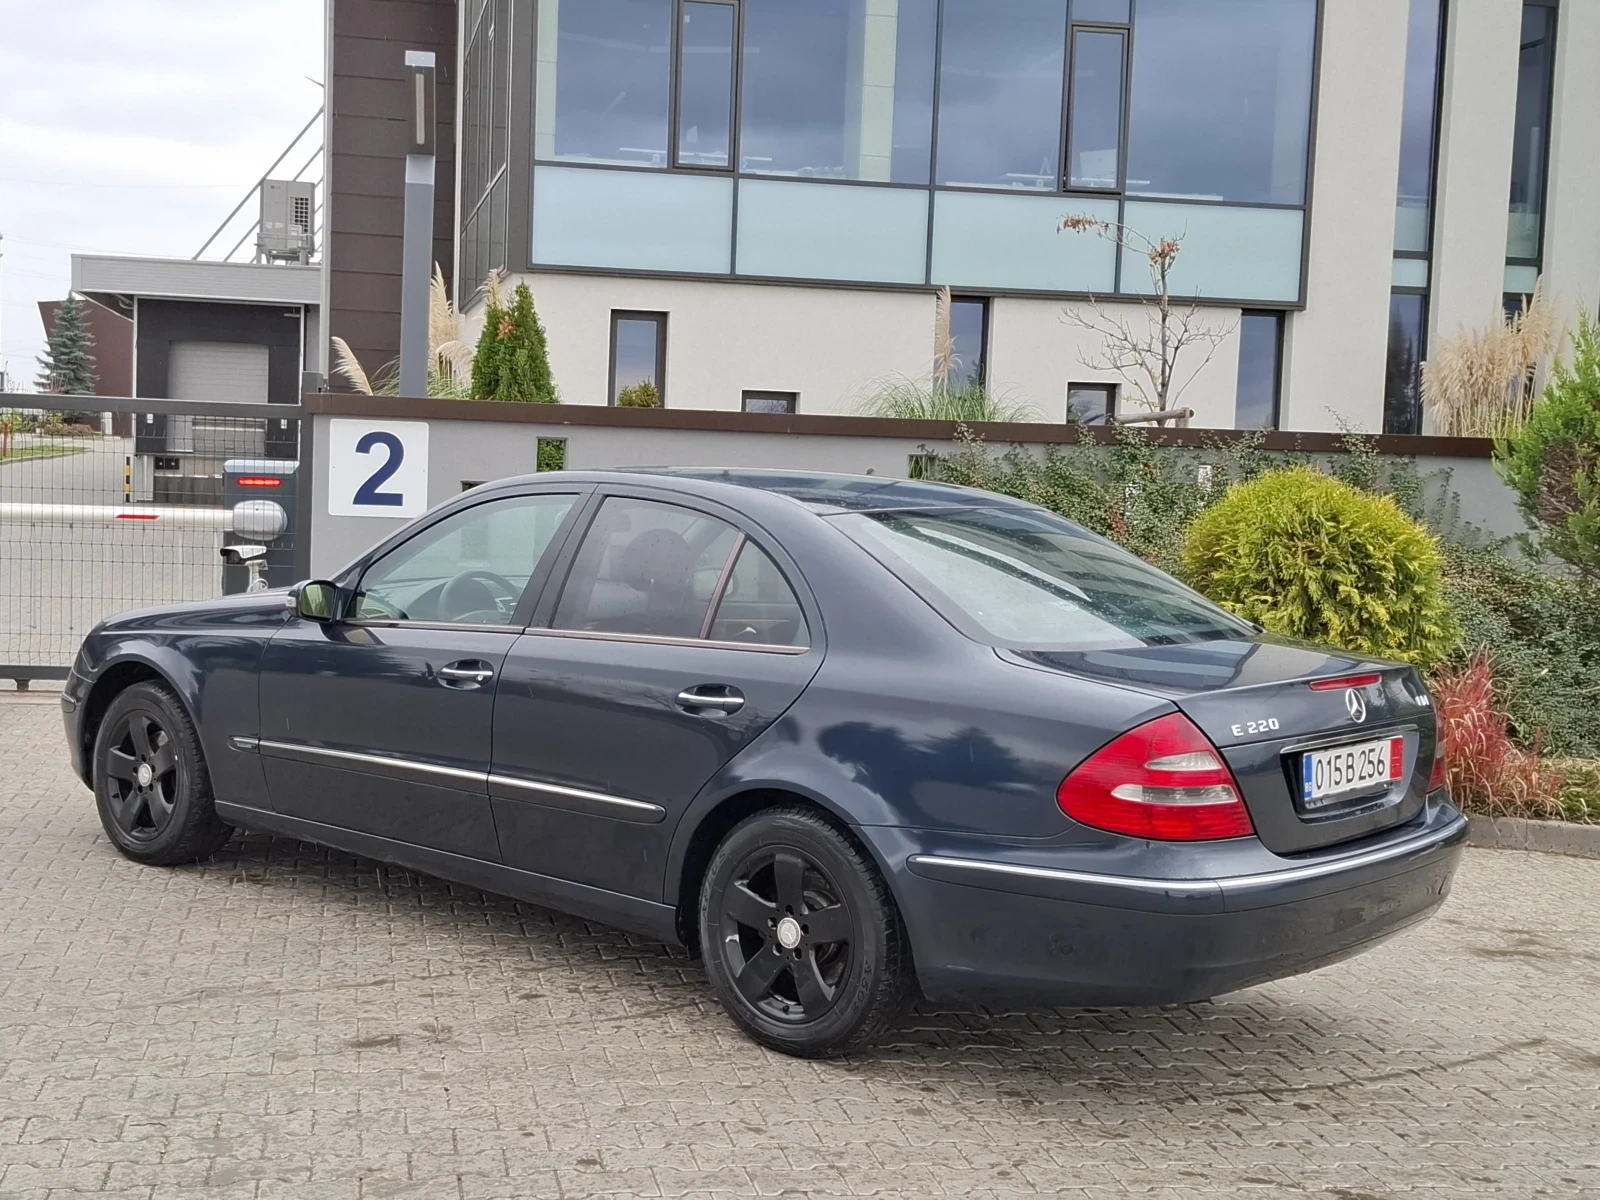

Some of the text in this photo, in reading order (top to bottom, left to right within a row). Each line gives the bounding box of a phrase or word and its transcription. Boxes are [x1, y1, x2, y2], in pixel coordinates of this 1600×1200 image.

[352, 431, 405, 507] 2
[1231, 717, 1280, 736] E 220
